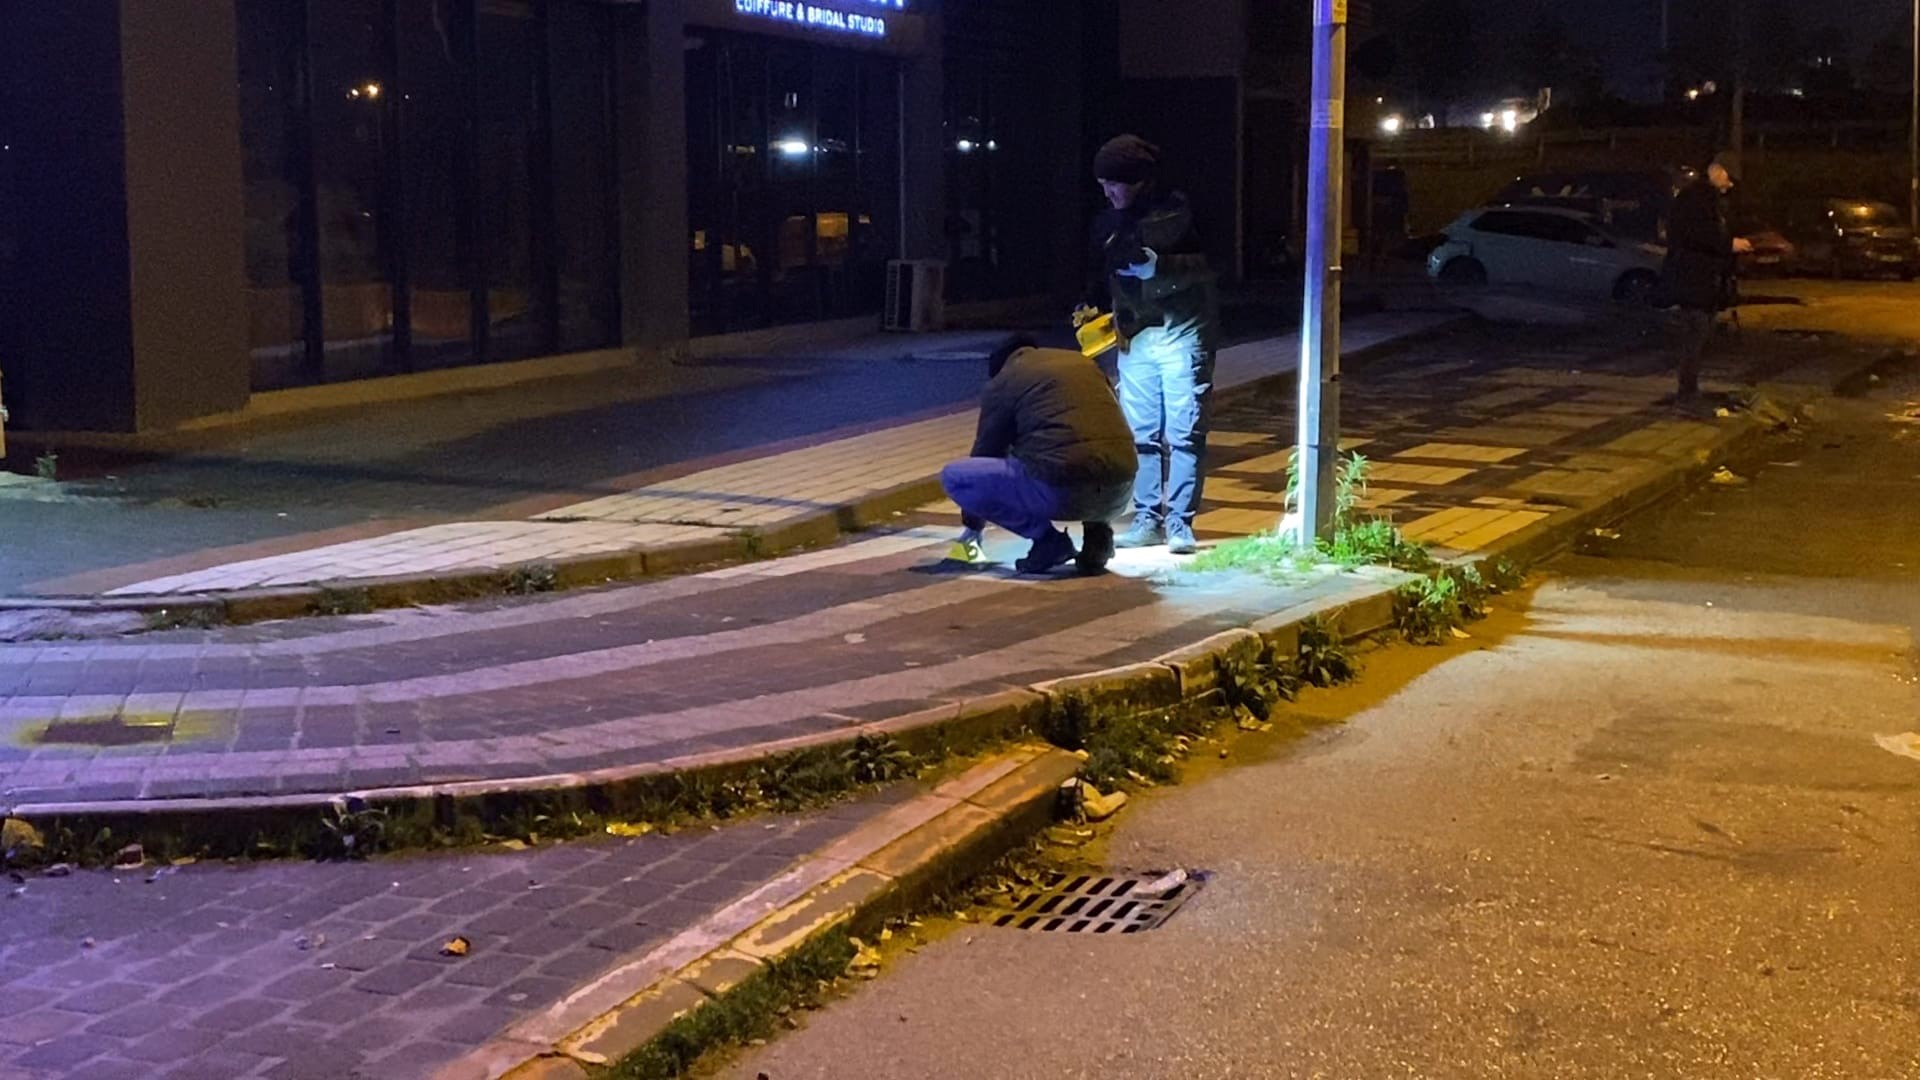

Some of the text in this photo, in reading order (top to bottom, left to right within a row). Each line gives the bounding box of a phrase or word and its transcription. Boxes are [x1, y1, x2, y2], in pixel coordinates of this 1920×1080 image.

[736, 0, 885, 34] COIFFURE & BRIDAL STUDIO
